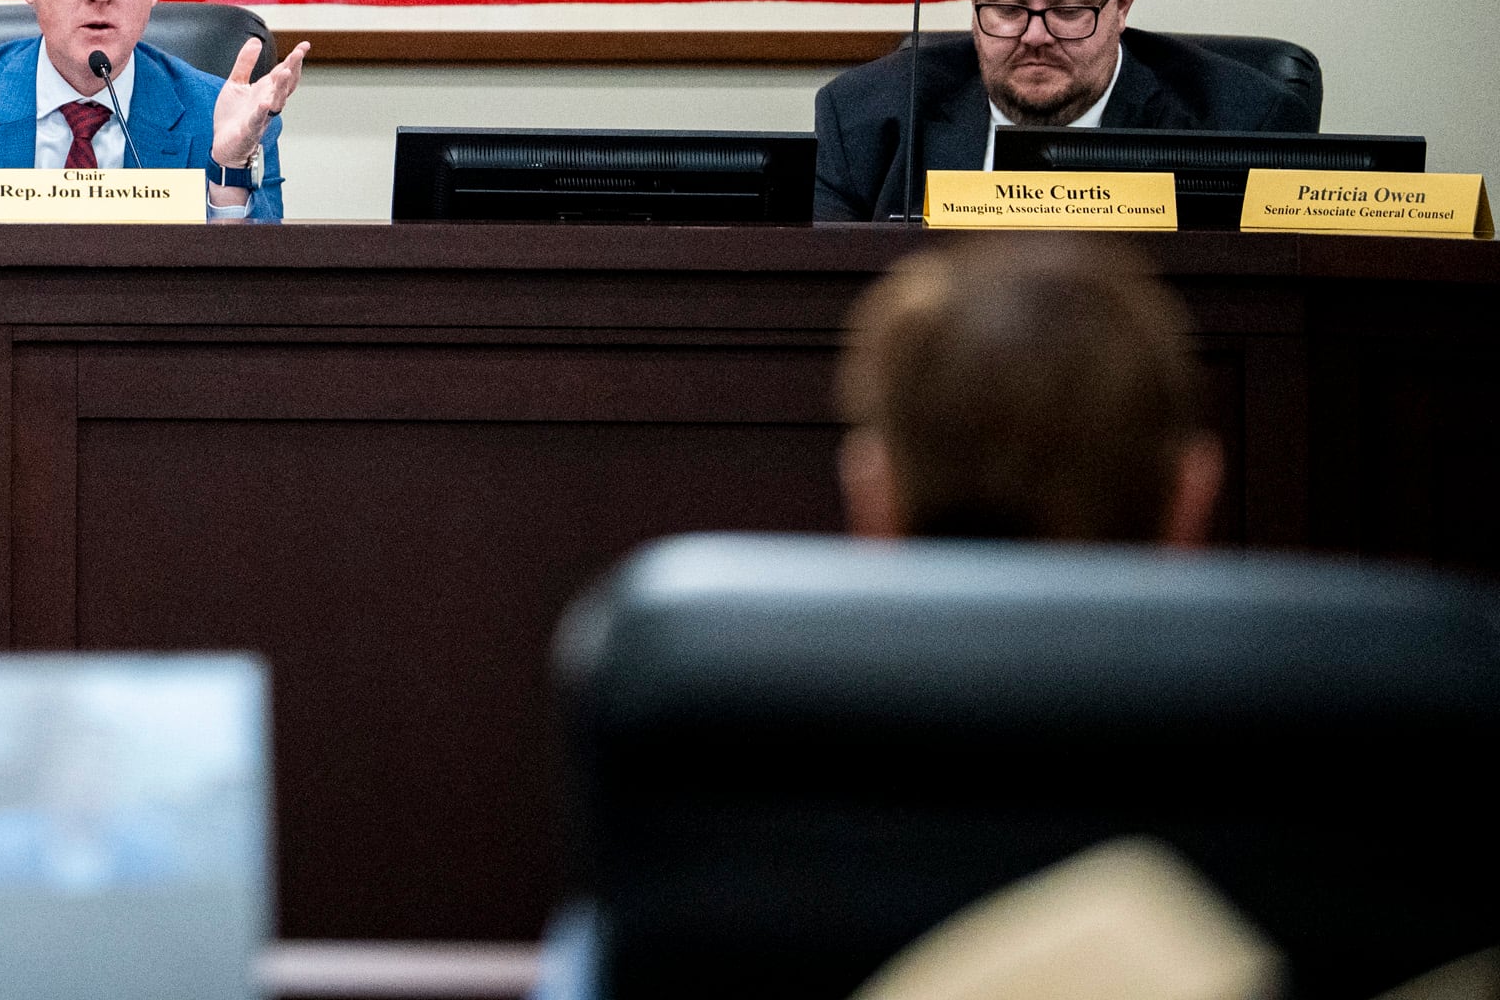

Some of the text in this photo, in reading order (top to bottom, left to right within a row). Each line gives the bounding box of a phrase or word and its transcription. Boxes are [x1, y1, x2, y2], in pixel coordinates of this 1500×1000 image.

[63, 170, 106, 181] Chair
[0, 185, 171, 201] Rep. Jon Hawkins
[995, 184, 1111, 200] Mike Curtis
[1297, 185, 1426, 204] Patricia Owen
[942, 202, 1166, 216] Managing Associate General Counsel
[1264, 204, 1454, 220] Senior Associate General Counsel
